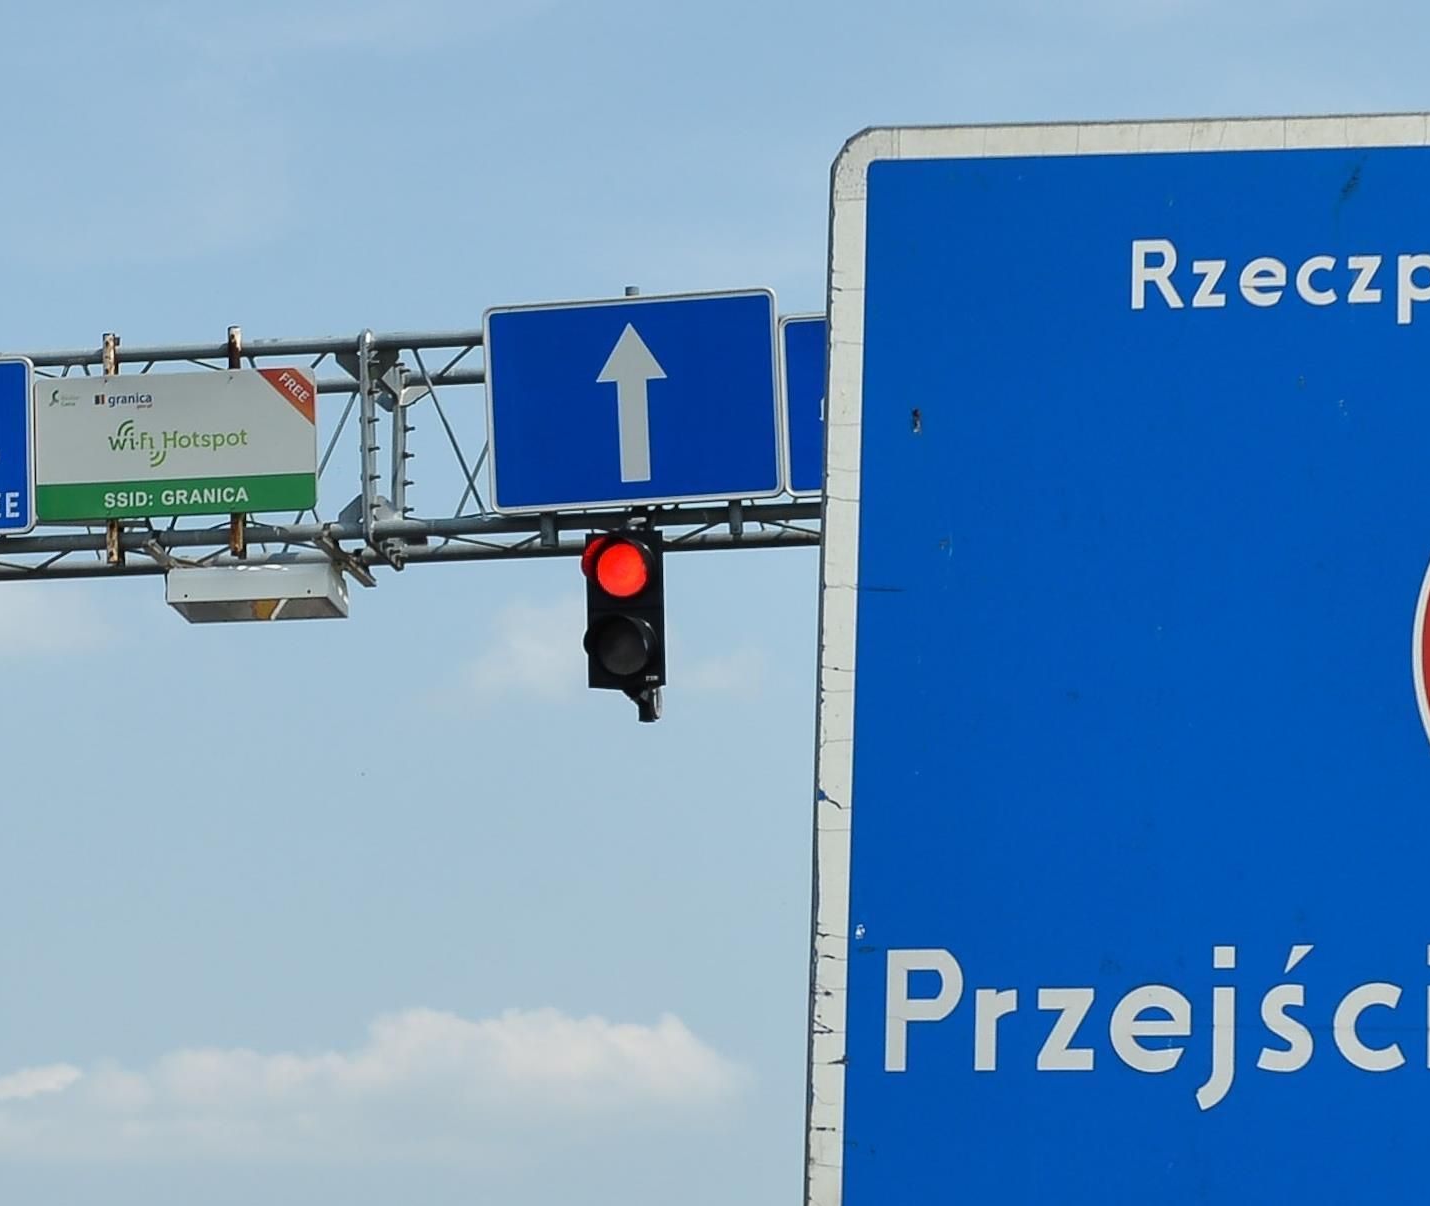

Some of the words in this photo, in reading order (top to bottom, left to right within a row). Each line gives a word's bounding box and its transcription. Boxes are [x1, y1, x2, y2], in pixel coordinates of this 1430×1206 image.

[278, 371, 310, 404] FREE
[108, 391, 153, 408] granica
[163, 428, 248, 452] Hotspot
[104, 491, 153, 508] SSID:
[161, 487, 249, 506] GRANICA
